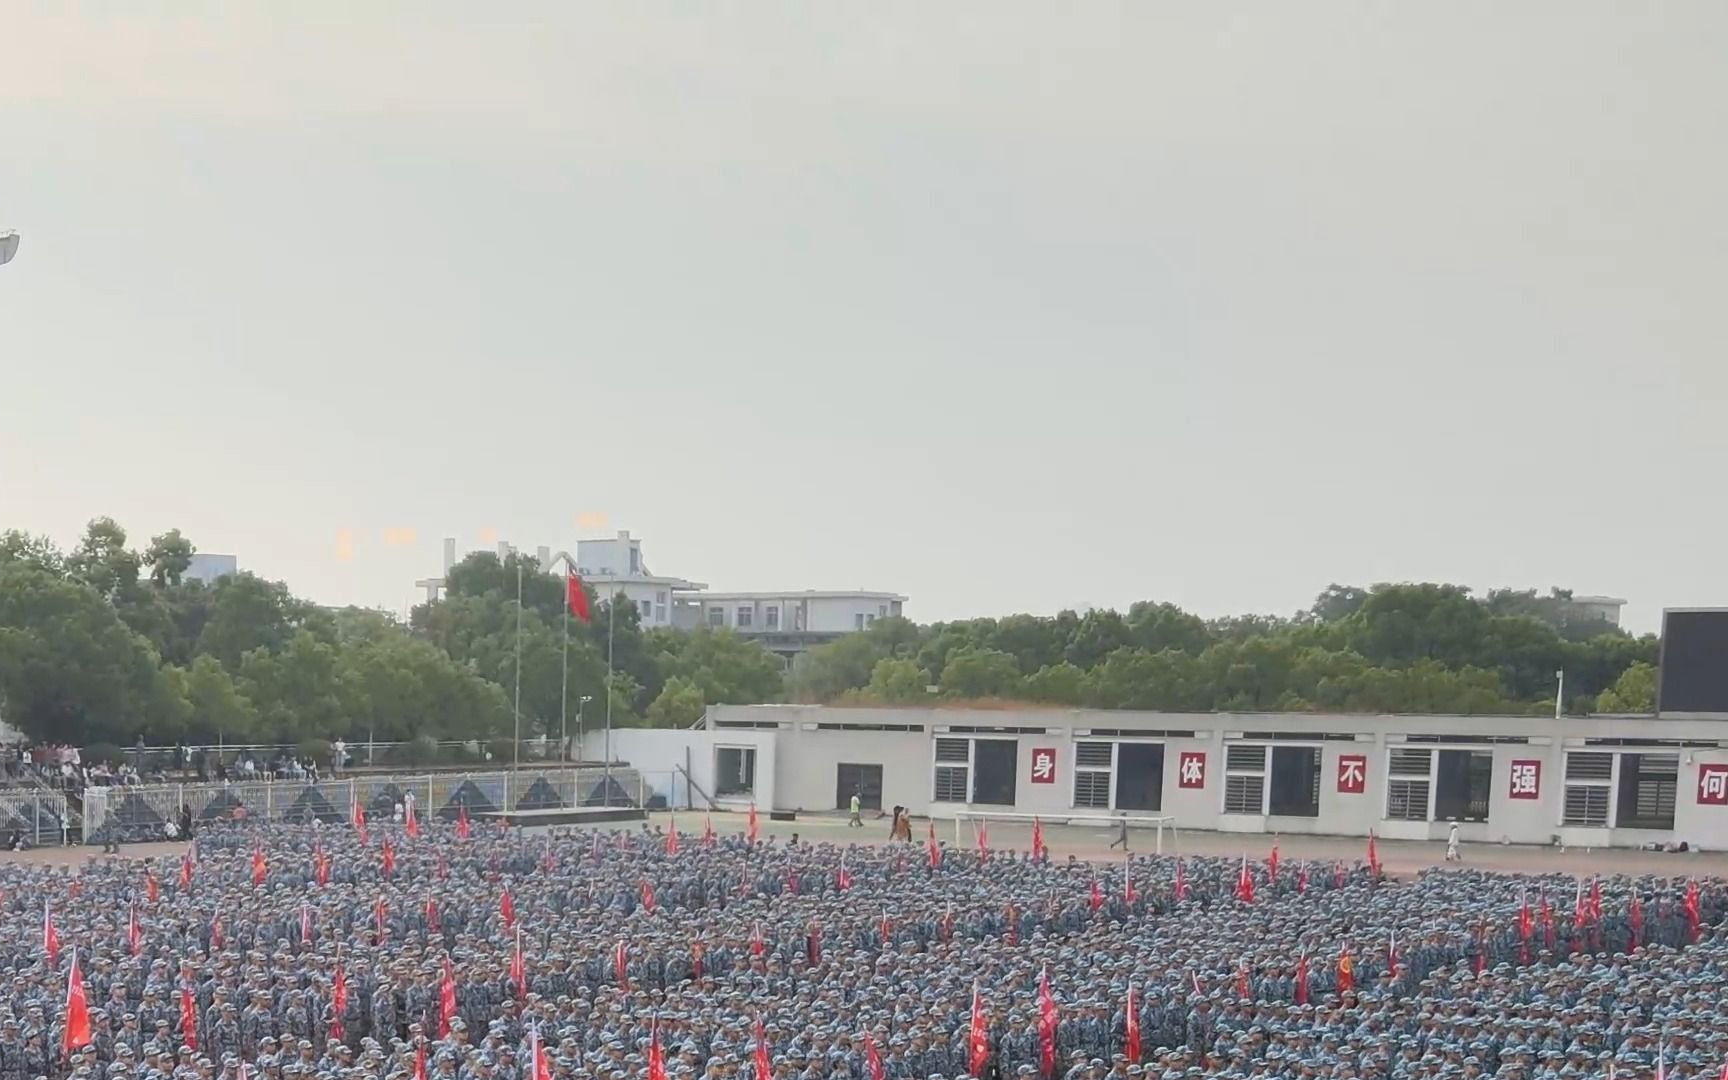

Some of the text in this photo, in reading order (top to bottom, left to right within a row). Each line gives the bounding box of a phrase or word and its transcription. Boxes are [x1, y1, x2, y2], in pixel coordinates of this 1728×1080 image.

[1033, 753, 1728, 798] 身 体 不 强 何
